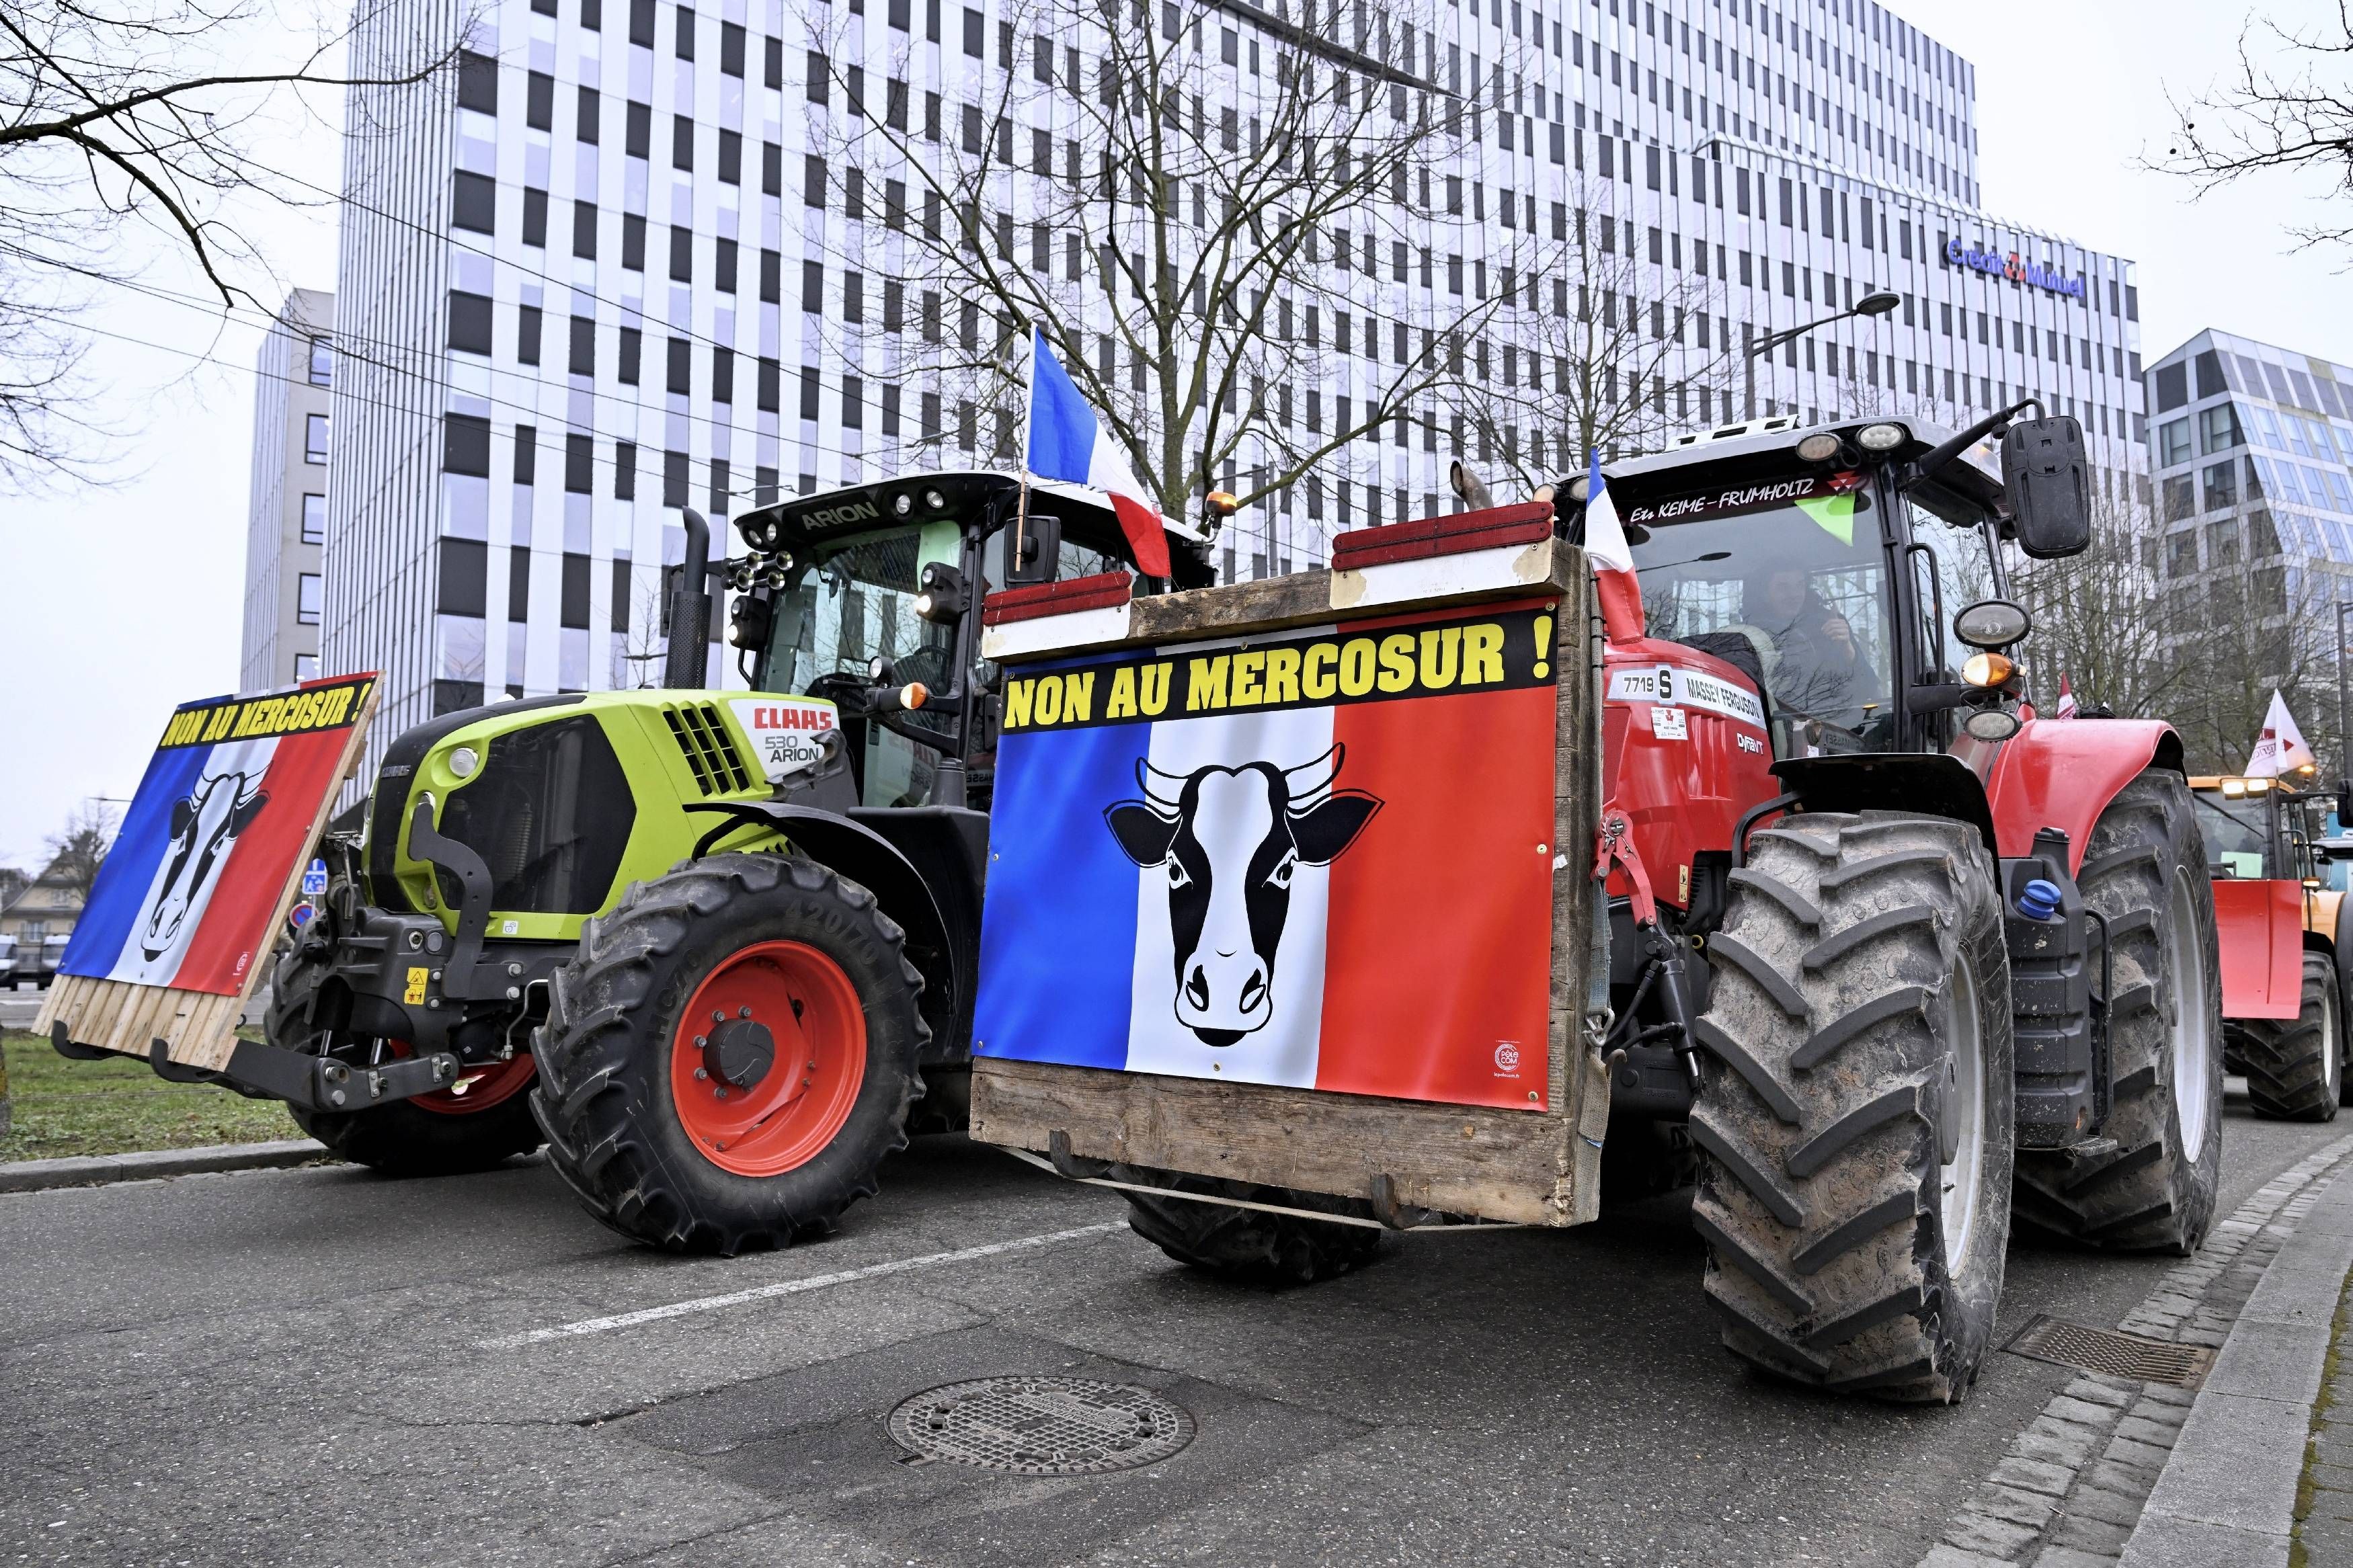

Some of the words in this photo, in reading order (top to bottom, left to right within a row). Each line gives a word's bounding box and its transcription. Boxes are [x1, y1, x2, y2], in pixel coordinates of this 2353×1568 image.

[2026, 261, 2084, 297] Mutuel
[801, 501, 879, 530] ARION
[1004, 670, 1095, 729] NON
[1106, 663, 1173, 718] AU
[1186, 622, 1506, 711] MERCOSUR
[1533, 615, 1554, 679] !
[1624, 677, 1654, 692] 7719
[1659, 669, 1672, 699] S
[1686, 677, 1720, 704] MASSEY
[1720, 688, 1760, 718] FERGUSON
[161, 709, 209, 746] NON
[201, 705, 239, 742] AU
[231, 686, 355, 738] MERCOSUR
[351, 682, 372, 722] !
[754, 708, 832, 730] CLAAS
[765, 736, 798, 749] 530
[770, 748, 819, 763] ARION
